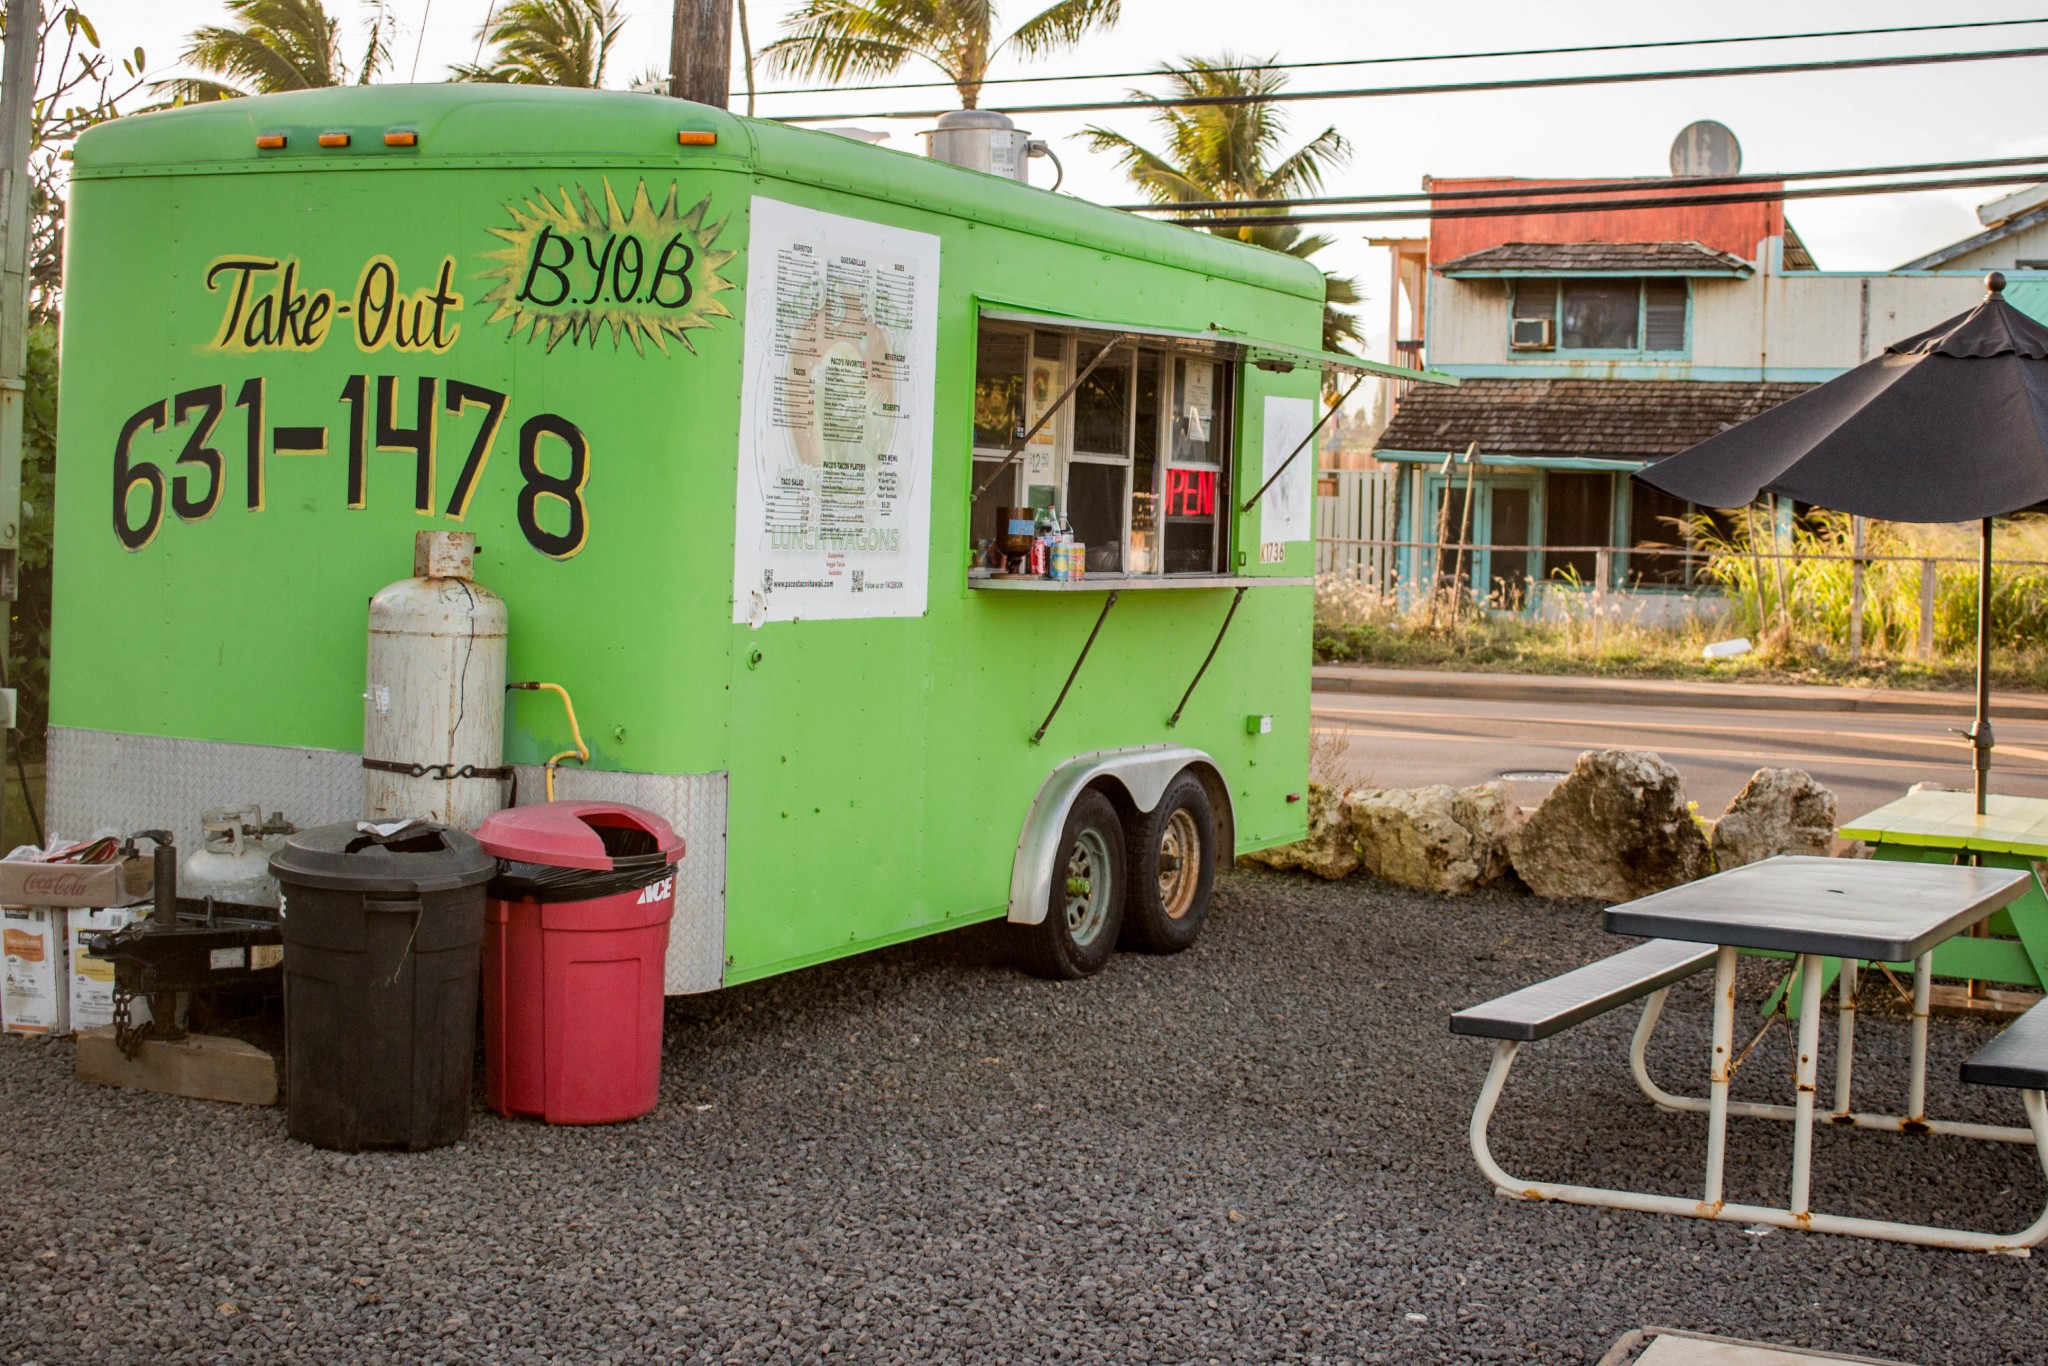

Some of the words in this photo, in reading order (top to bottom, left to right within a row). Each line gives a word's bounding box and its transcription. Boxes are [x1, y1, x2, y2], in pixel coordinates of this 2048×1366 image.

[207, 260, 459, 350] Take-Out
[112, 374, 591, 562] 631-1478
[771, 526, 826, 551] LUNCH
[636, 876, 673, 904] ACE
